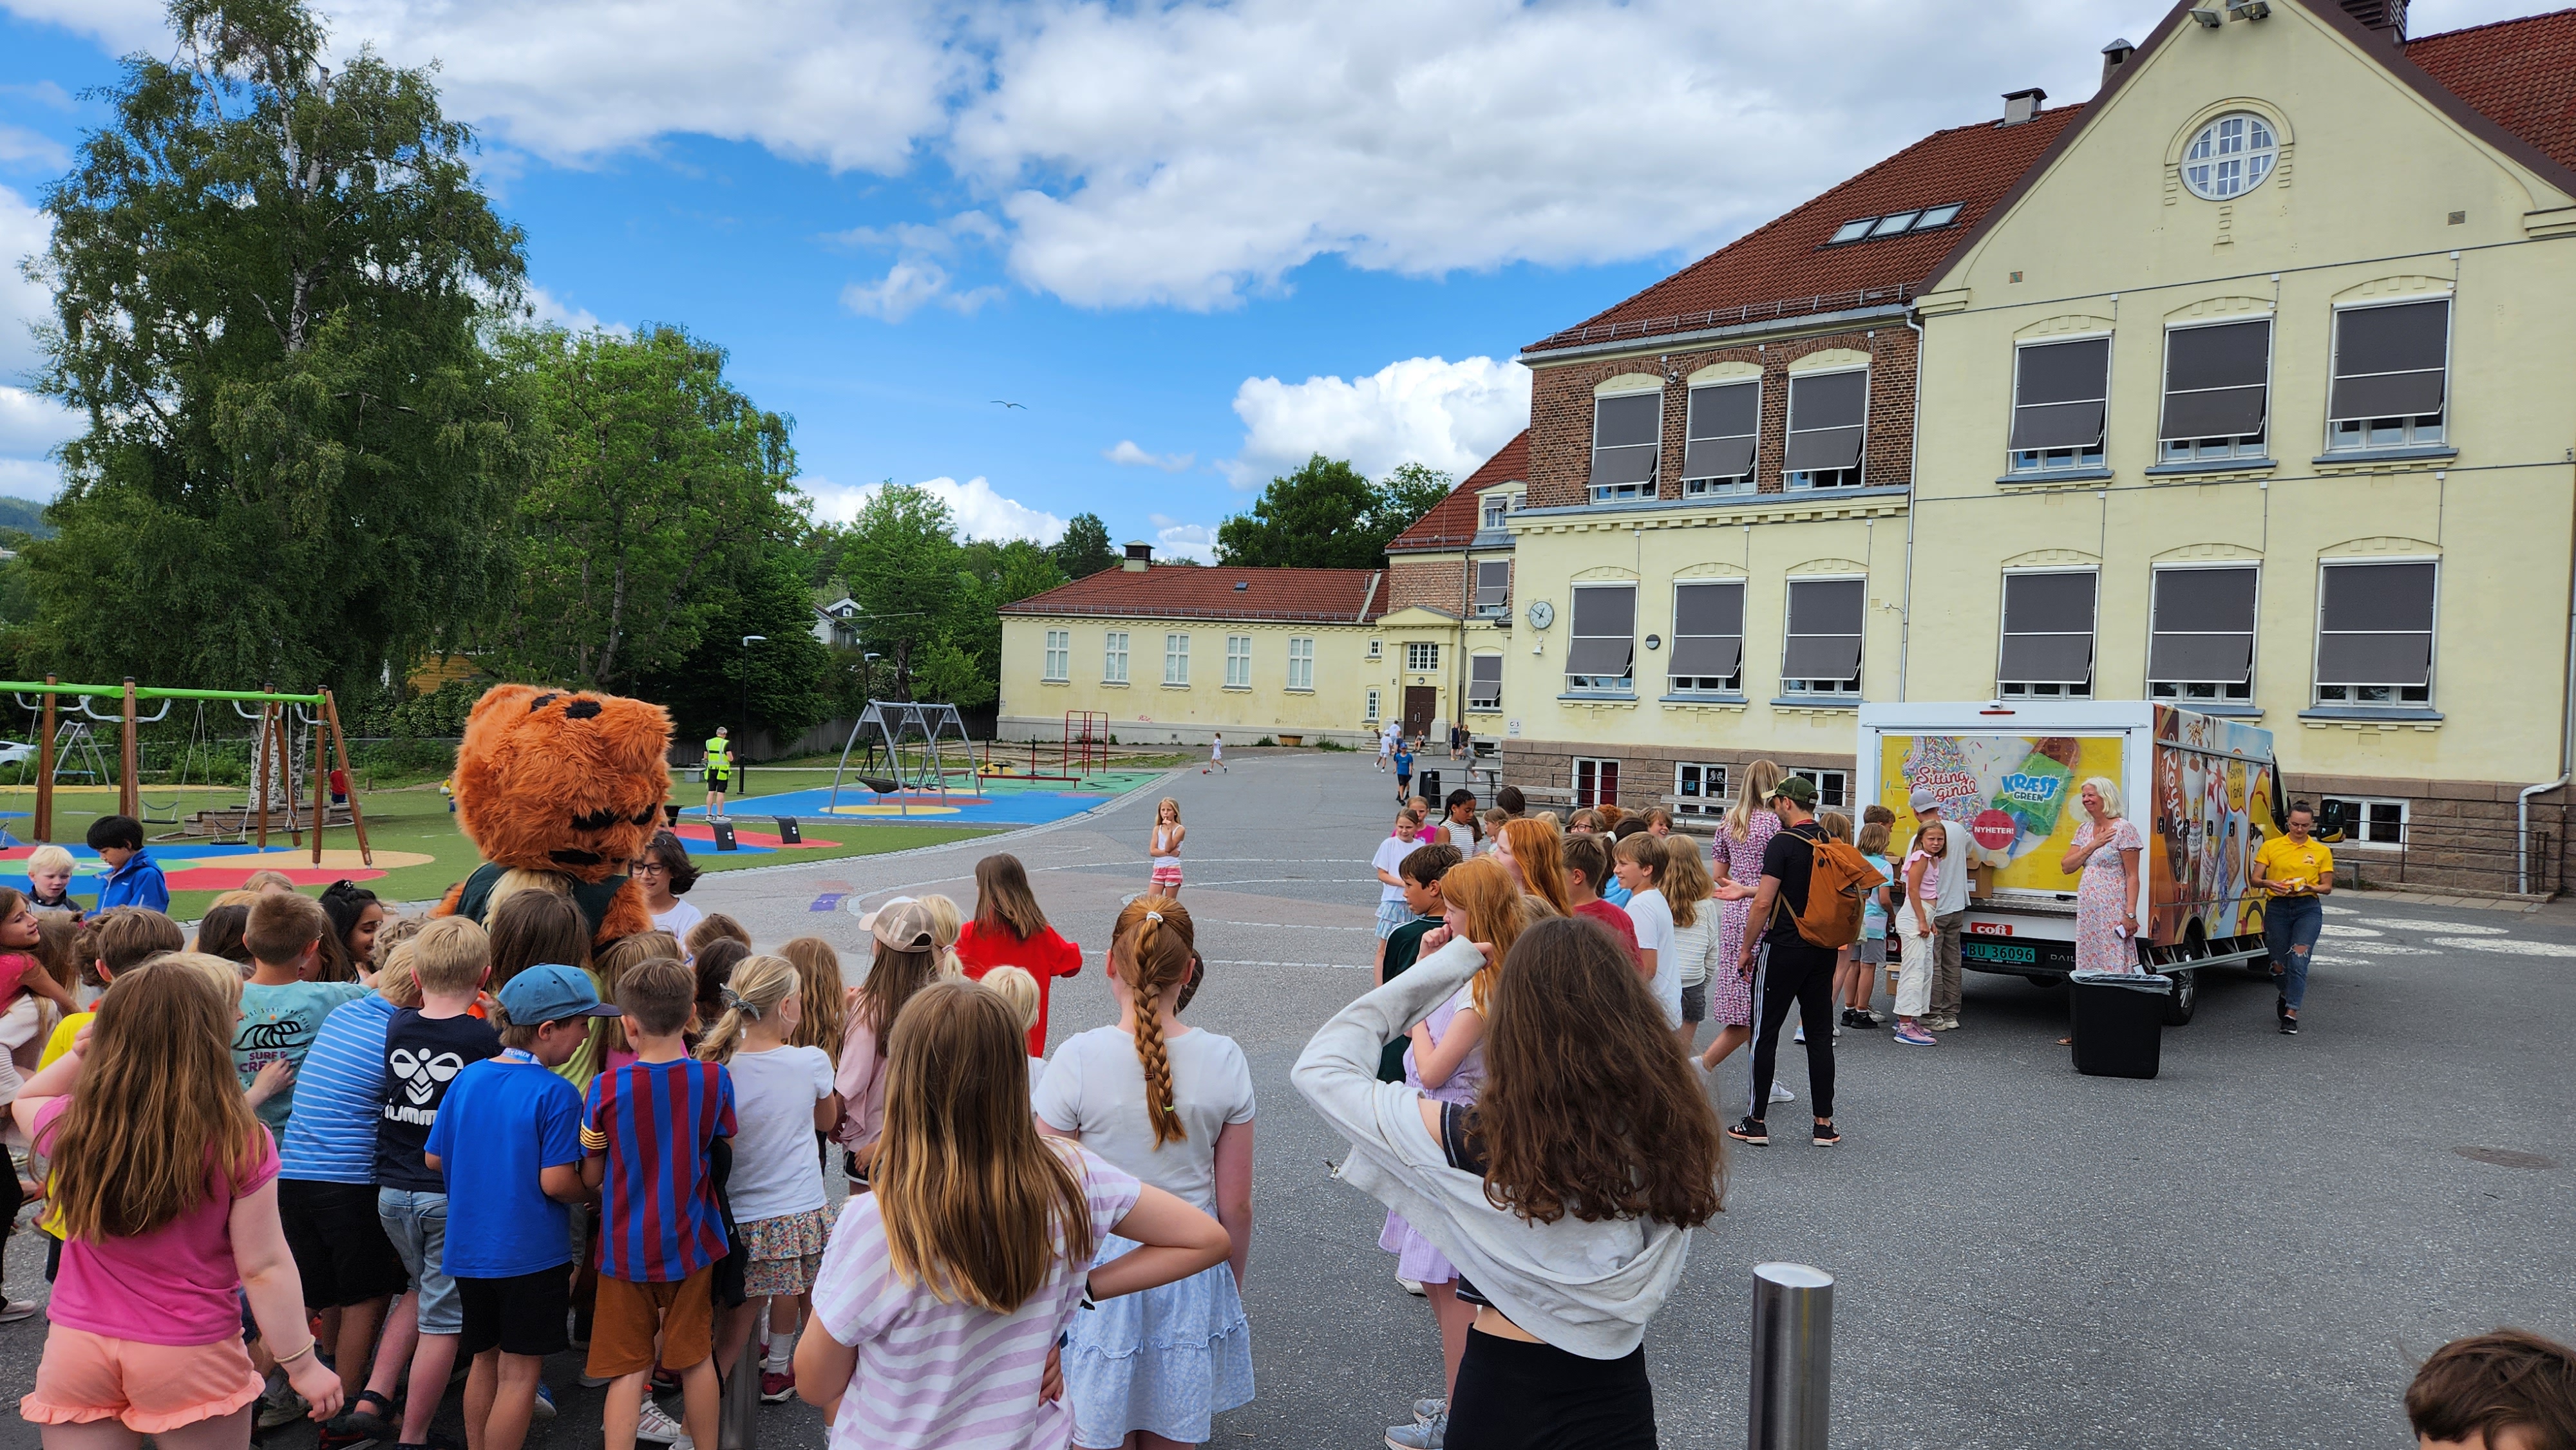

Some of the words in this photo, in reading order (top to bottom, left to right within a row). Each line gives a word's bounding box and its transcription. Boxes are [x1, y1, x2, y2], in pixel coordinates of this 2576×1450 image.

[1916, 766, 1970, 786] Sitting
[1910, 782, 1979, 803] iginal
[2014, 791, 2044, 802] GREEN
[1974, 826, 2014, 834] NYHETER!
[1969, 945, 1986, 957] BU
[1992, 946, 2033, 961] 36096
[2050, 954, 2076, 962] DAIL
[249, 1051, 278, 1060] SURF
